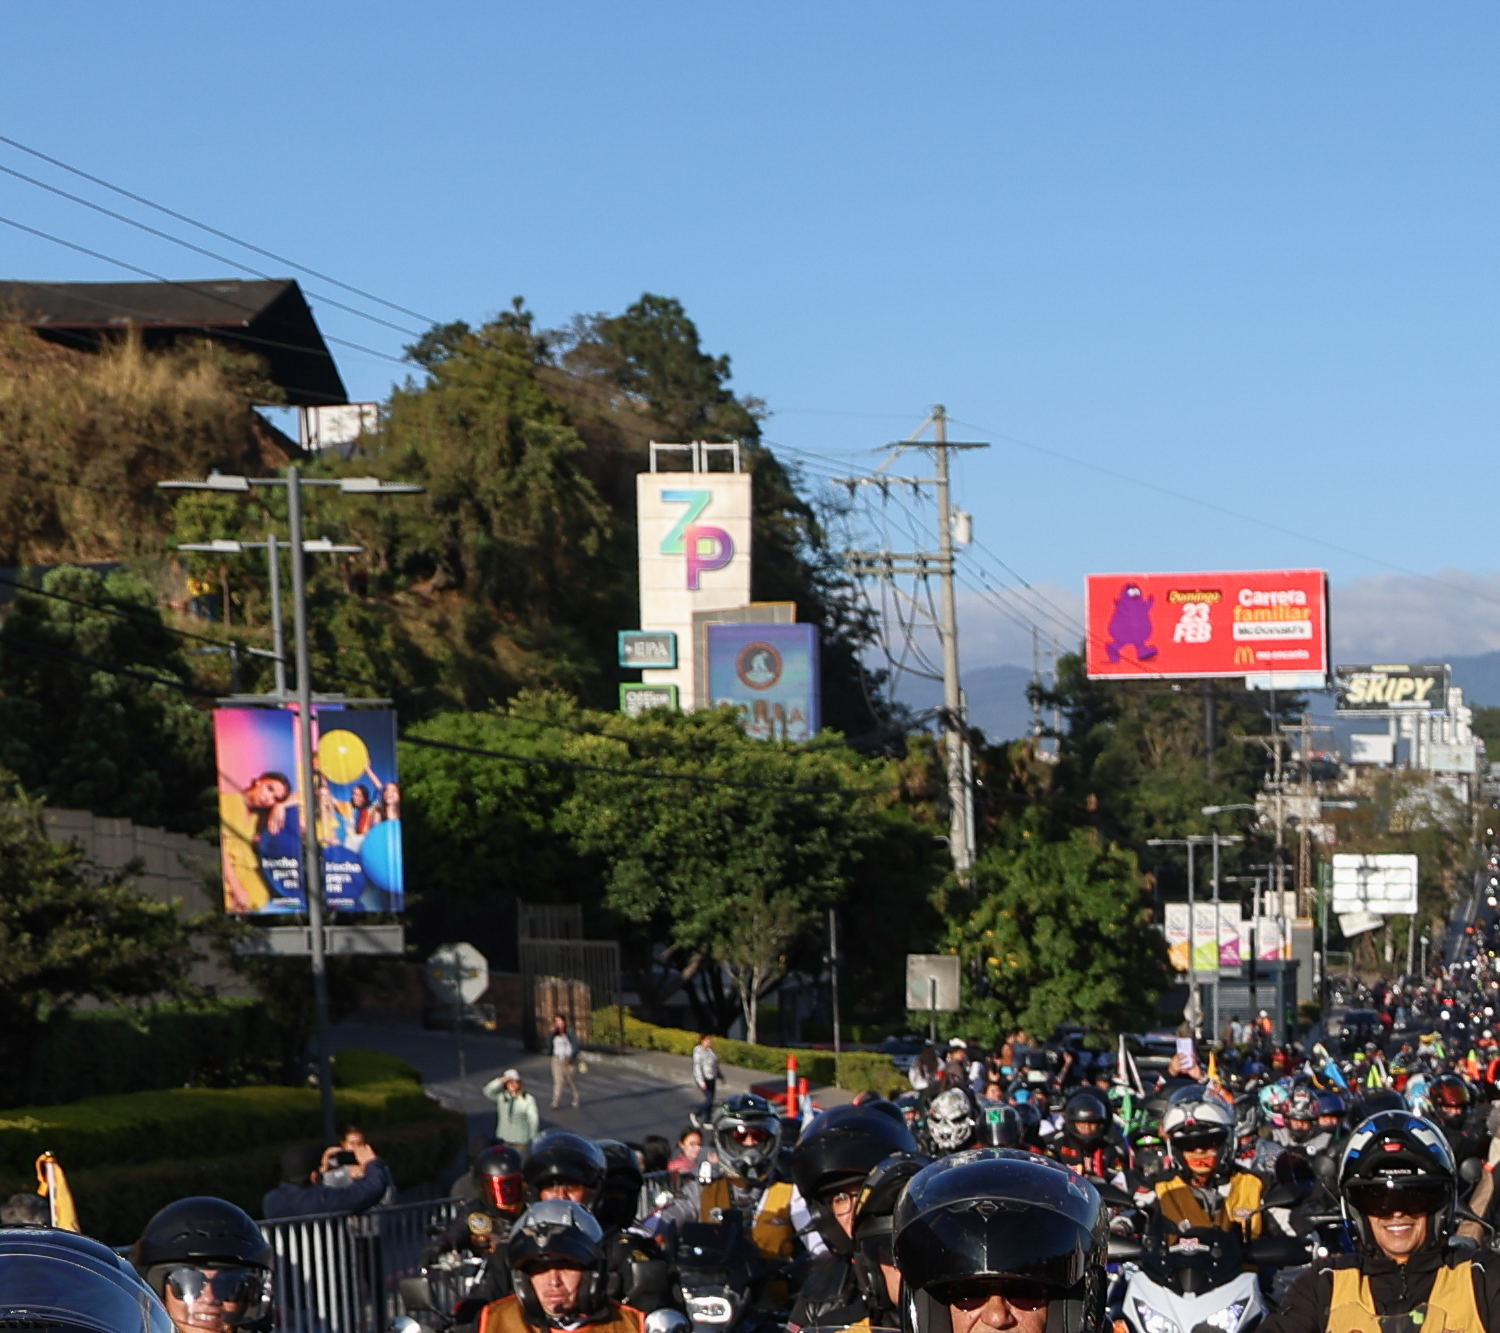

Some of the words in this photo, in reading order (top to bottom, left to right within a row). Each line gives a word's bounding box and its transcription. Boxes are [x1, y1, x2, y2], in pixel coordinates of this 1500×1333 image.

[1181, 603, 1210, 623] 23
[1234, 605, 1312, 621] familiar
[1174, 622, 1212, 642] FEB
[633, 642, 668, 657] EPA
[1346, 677, 1435, 703] SKIPY
